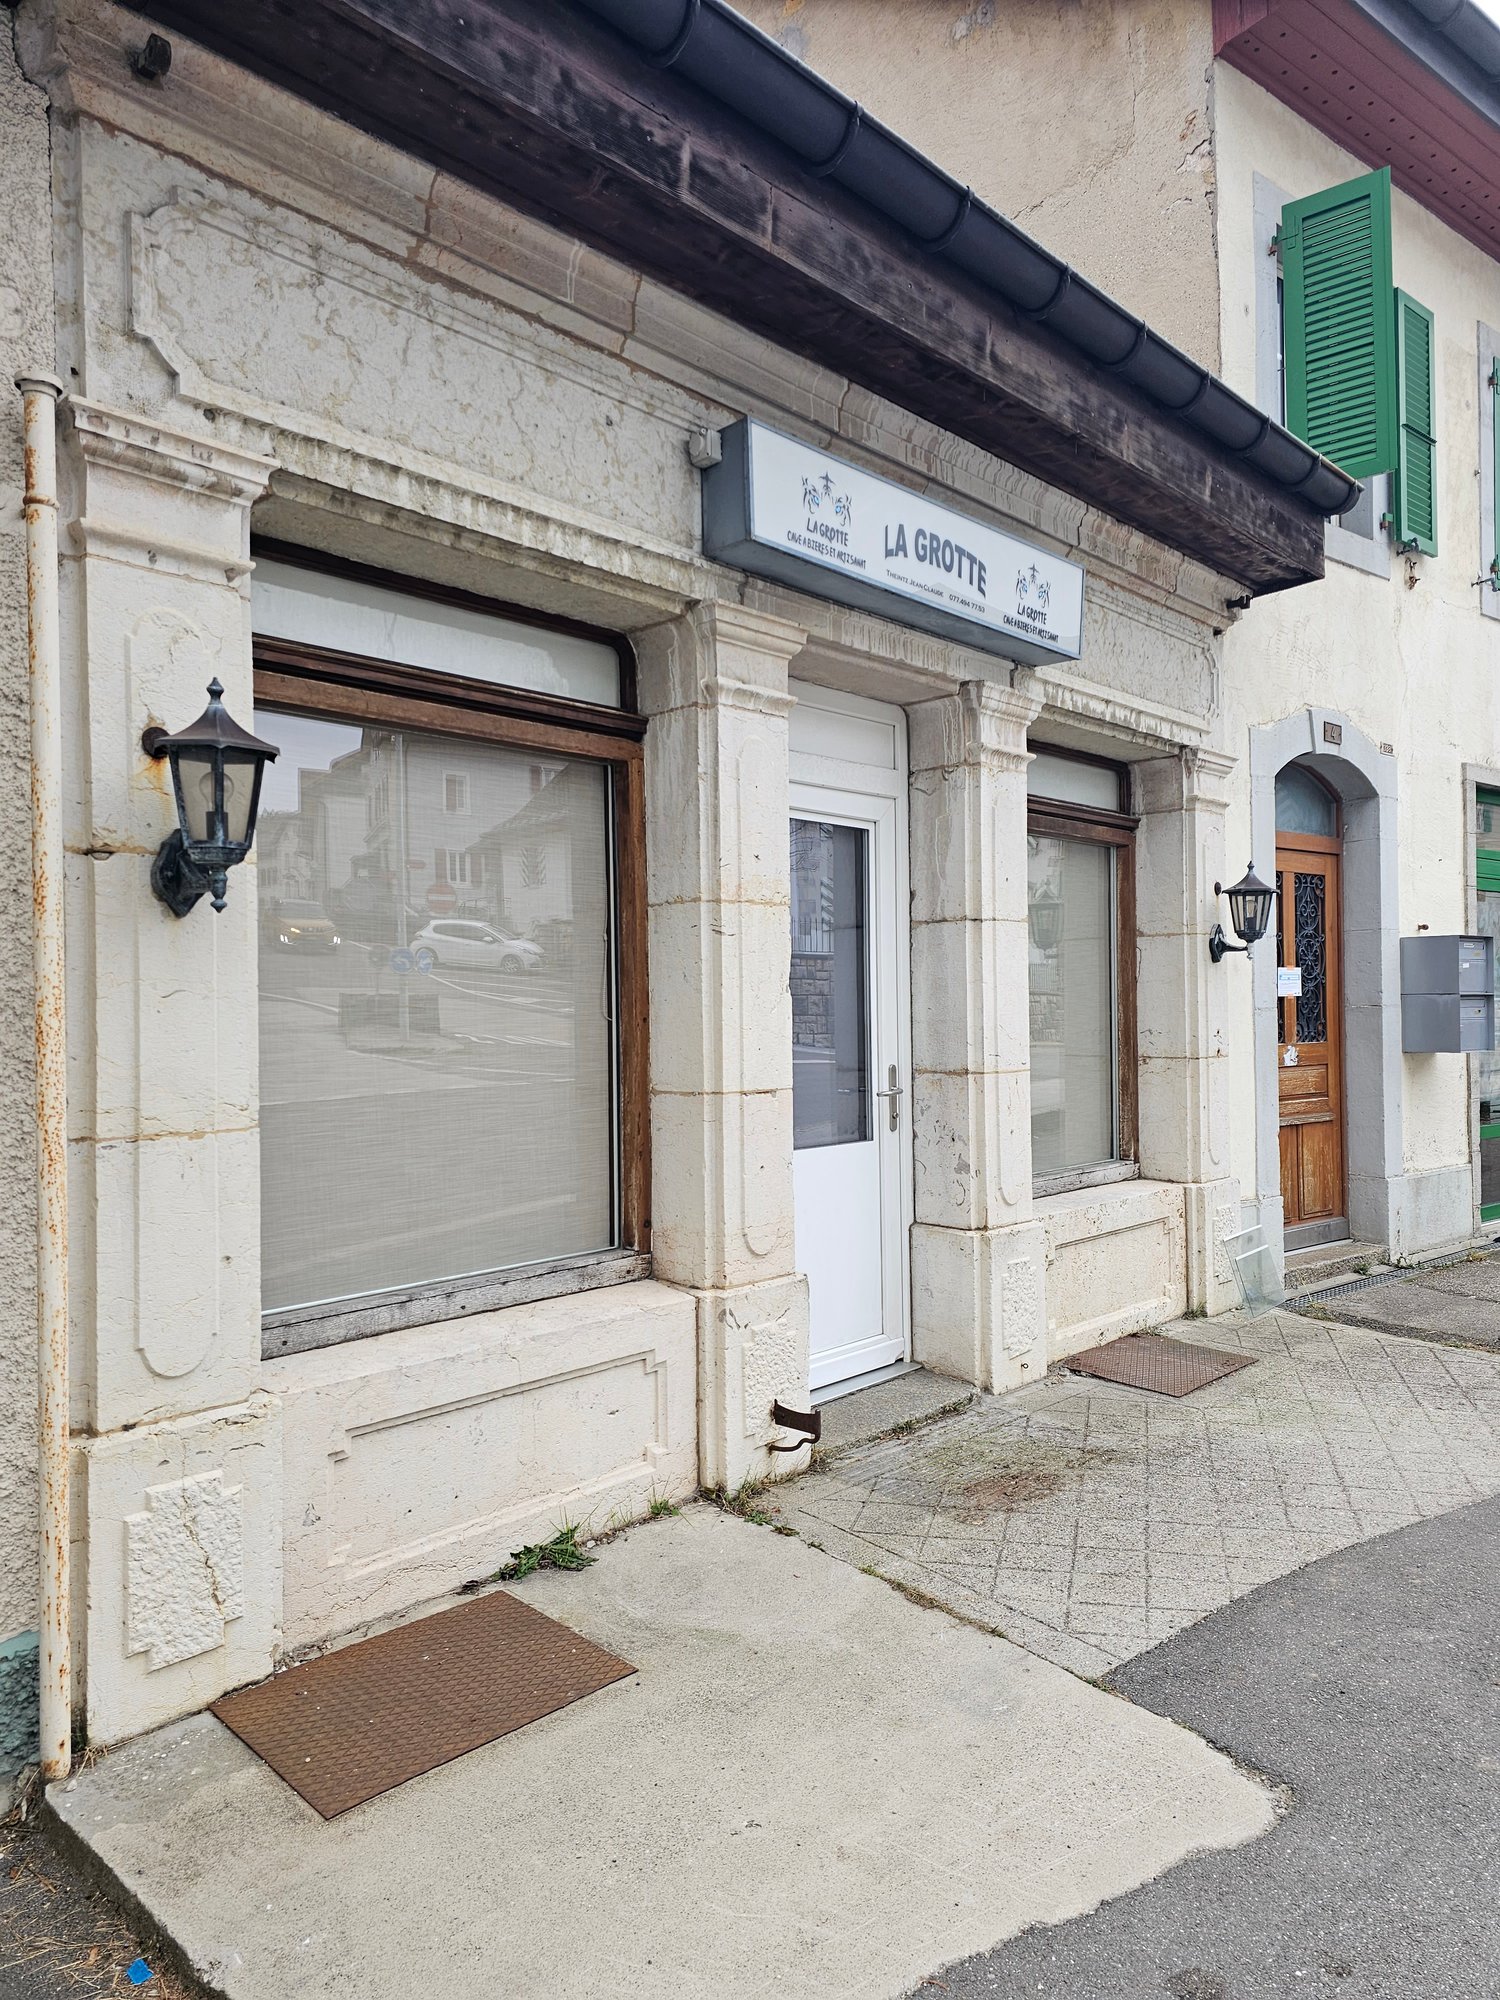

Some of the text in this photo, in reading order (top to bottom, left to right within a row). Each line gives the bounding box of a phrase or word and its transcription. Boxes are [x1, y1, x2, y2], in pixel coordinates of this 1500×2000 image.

[819, 522, 848, 547] GROTTE
[885, 523, 987, 600] LA GROTTE
[1330, 726, 1337, 740] 4
